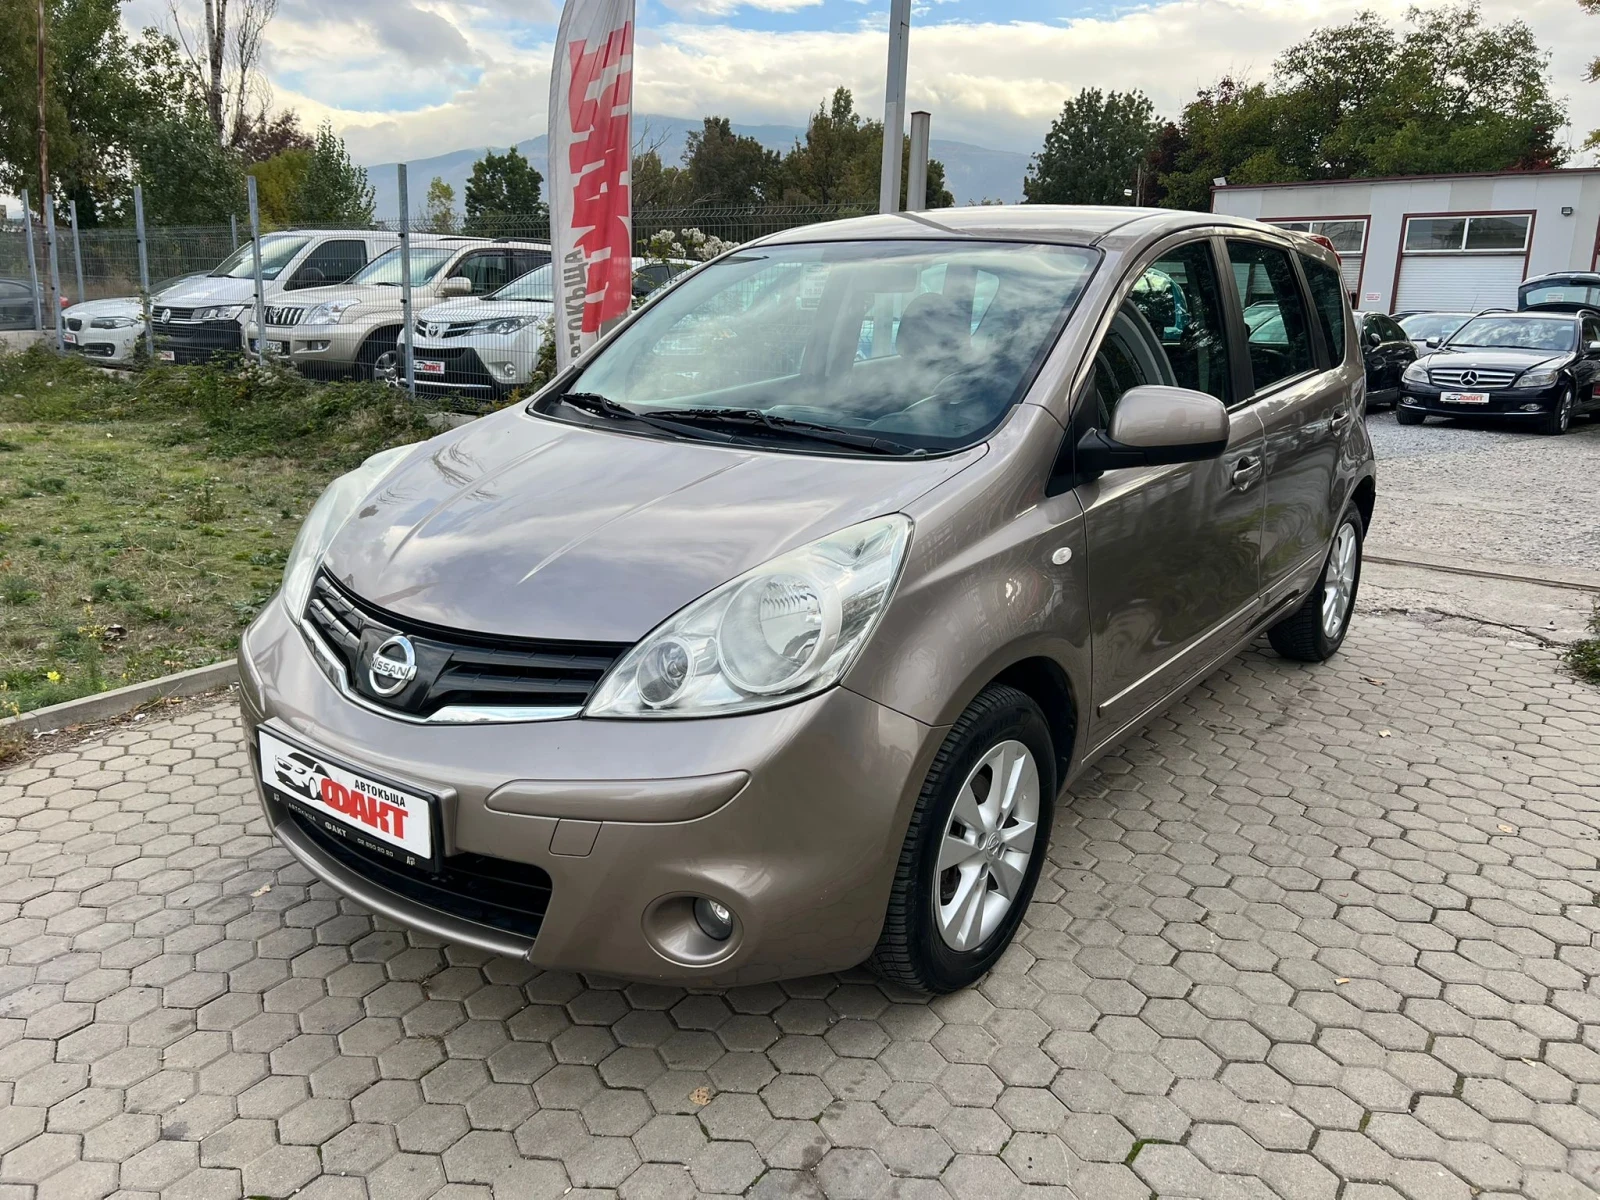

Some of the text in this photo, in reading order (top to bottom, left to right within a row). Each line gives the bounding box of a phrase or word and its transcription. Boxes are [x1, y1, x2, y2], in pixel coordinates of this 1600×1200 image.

[563, 248, 589, 359] ВТОКЪЩА
[371, 656, 408, 677] NISSAN
[354, 779, 406, 808] АВТОКЪЩА
[320, 777, 409, 840] ФАКТ
[324, 821, 347, 838] ФАКТ
